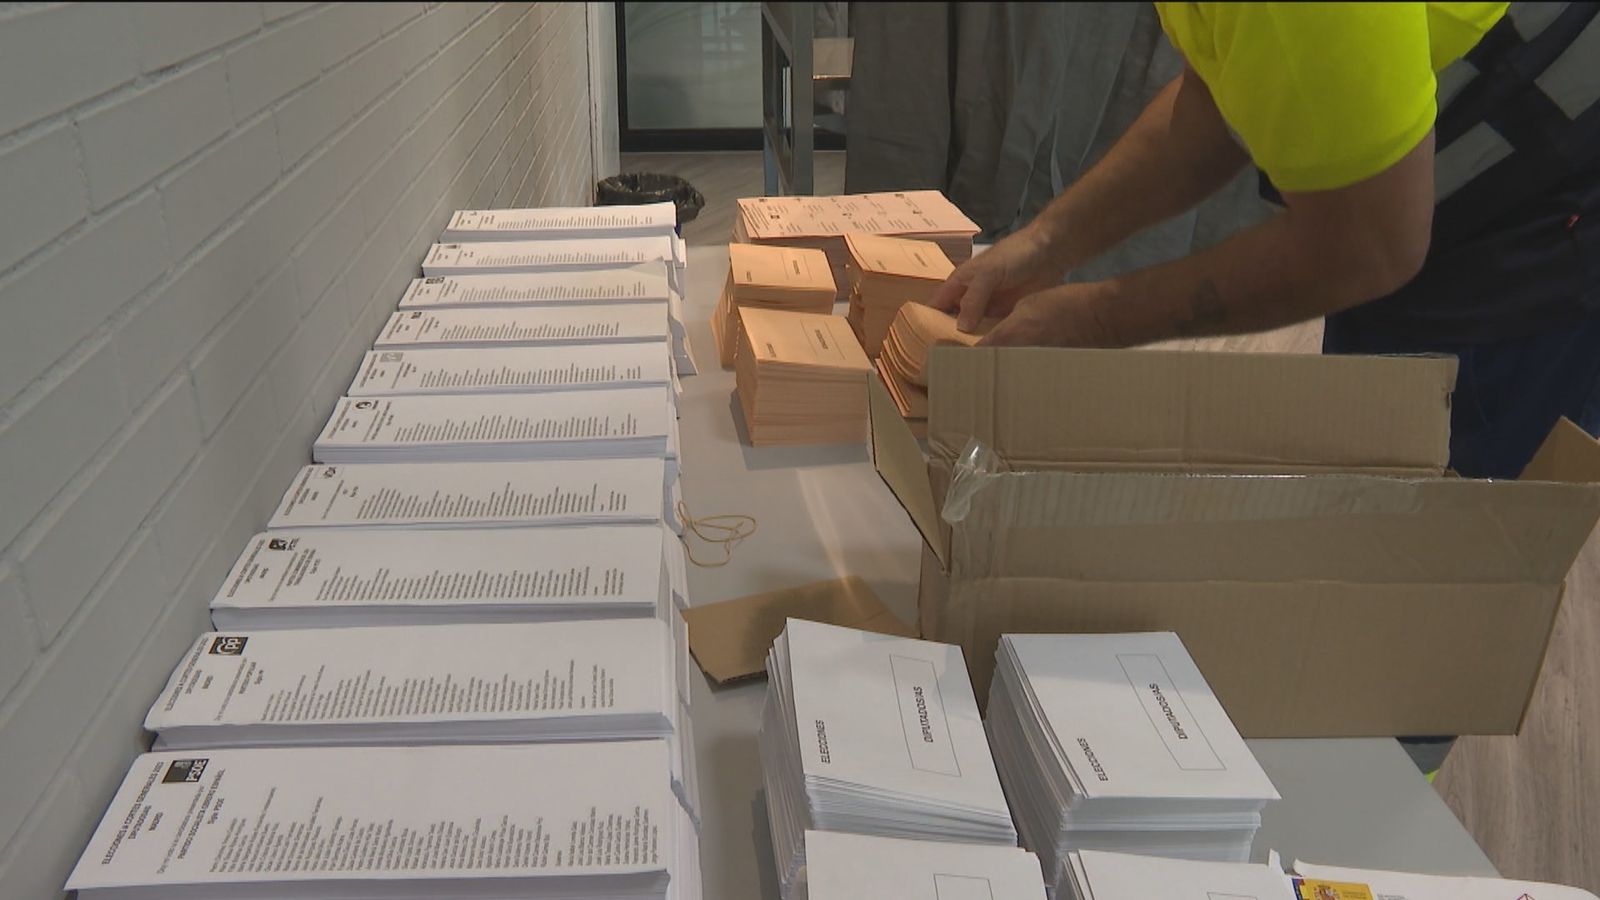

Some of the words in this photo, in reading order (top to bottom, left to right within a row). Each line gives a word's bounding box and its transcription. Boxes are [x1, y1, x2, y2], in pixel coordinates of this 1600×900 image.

[913, 686, 934, 743] DIPUTADOS/AS
[1150, 683, 1188, 739] DIPUTADOS/AS
[815, 720, 831, 764] ELECCIONES
[1077, 737, 1109, 781] ELECCIONES
